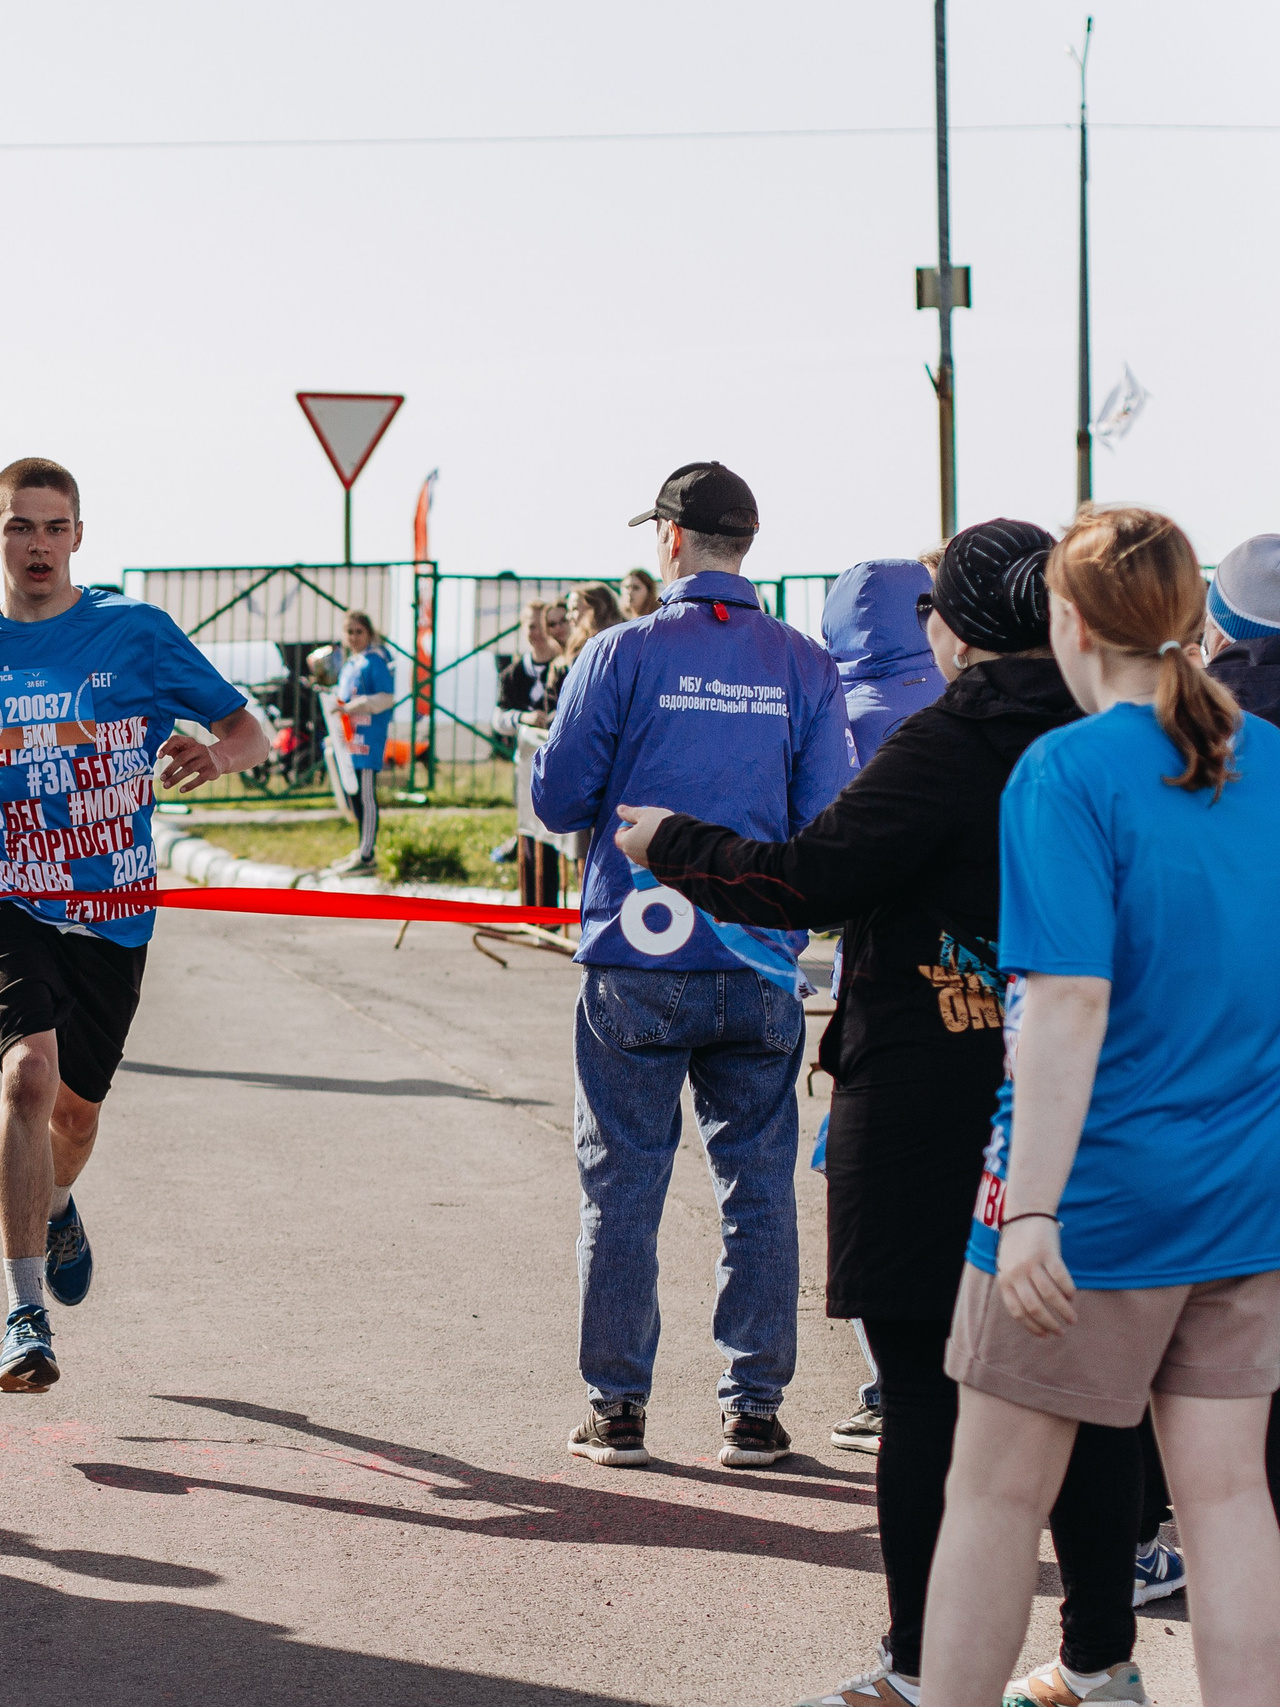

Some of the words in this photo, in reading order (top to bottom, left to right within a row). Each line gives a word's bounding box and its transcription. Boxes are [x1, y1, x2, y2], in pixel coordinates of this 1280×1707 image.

[679, 675, 702, 693] МБУ
[705, 679, 786, 701] «Физкультурно-
[5, 692, 72, 724] 20037
[659, 694, 747, 714] оздоровительный
[22, 723, 57, 749] 5КМ
[5, 815, 134, 864] #ГОРДОСТЬ
[111, 842, 157, 888] 2024
